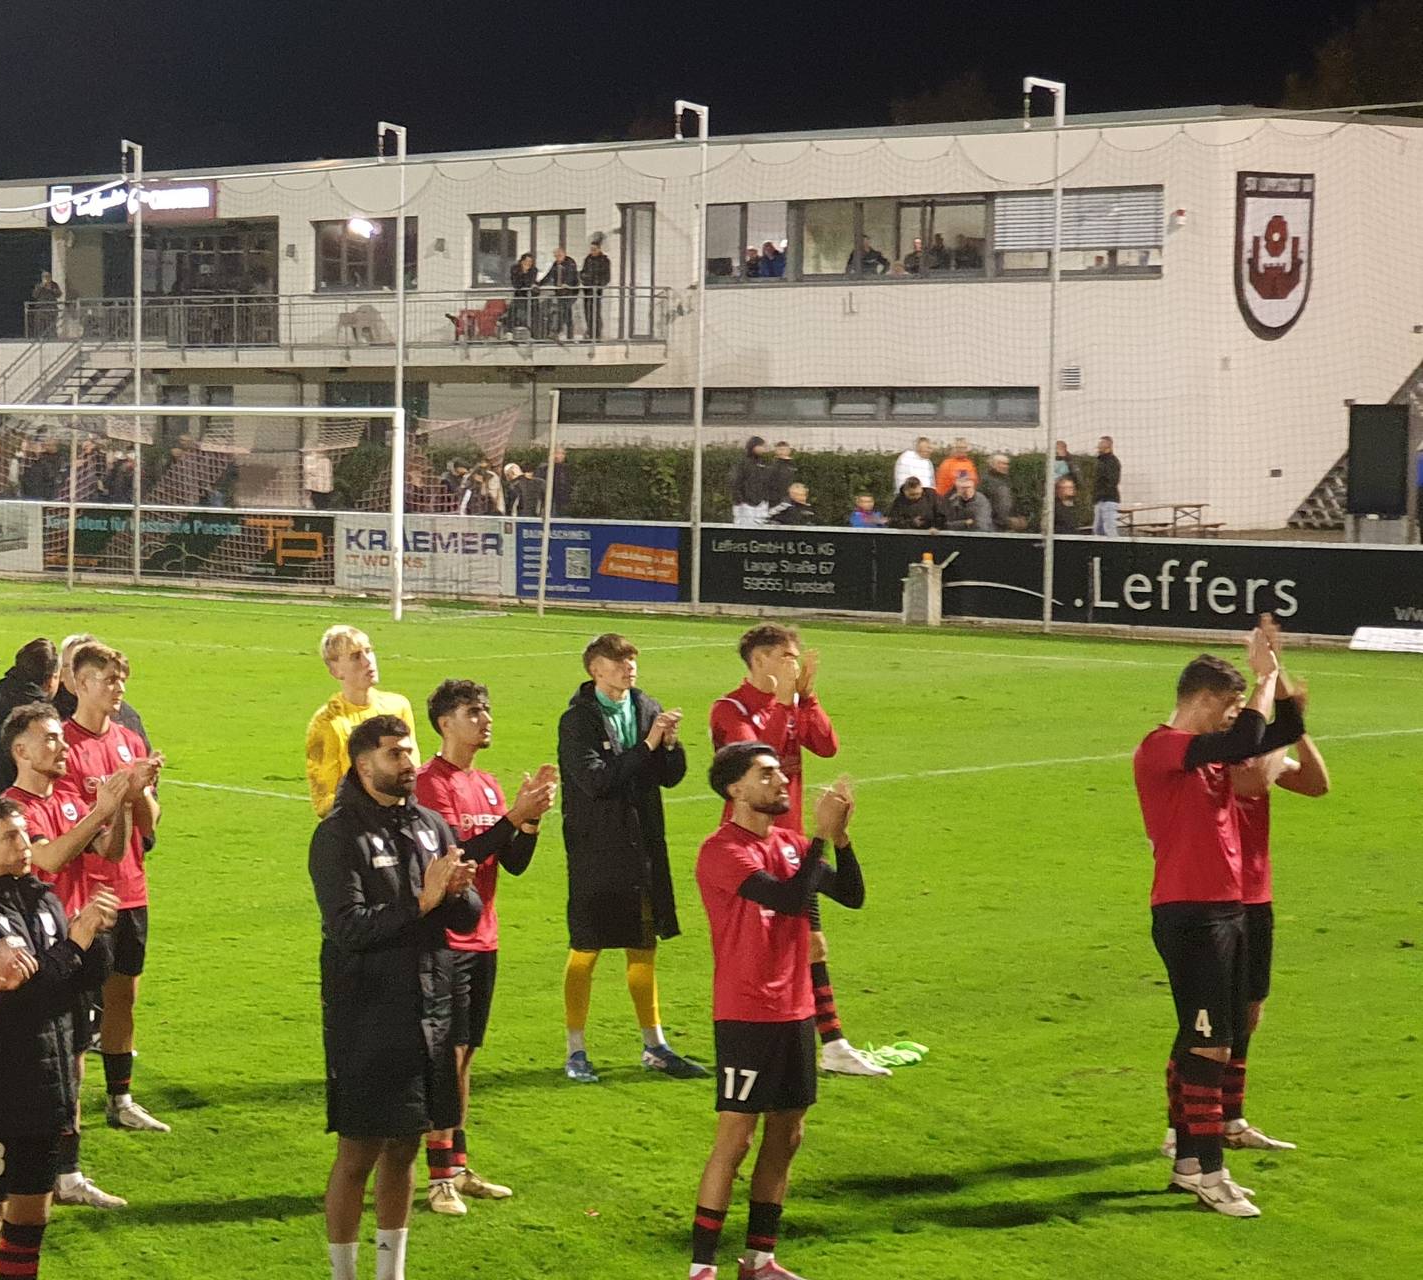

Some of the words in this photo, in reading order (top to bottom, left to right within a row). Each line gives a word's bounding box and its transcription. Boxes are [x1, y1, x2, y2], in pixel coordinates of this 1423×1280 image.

[712, 540, 748, 553] Leffers
[749, 540, 785, 554] GmbH
[797, 541, 817, 555] Co.
[744, 559, 778, 575] Lange
[780, 560, 817, 574] Straße
[784, 580, 835, 594] Lippstadt
[1195, 1009, 1213, 1038] 4
[724, 1067, 759, 1101] 17
